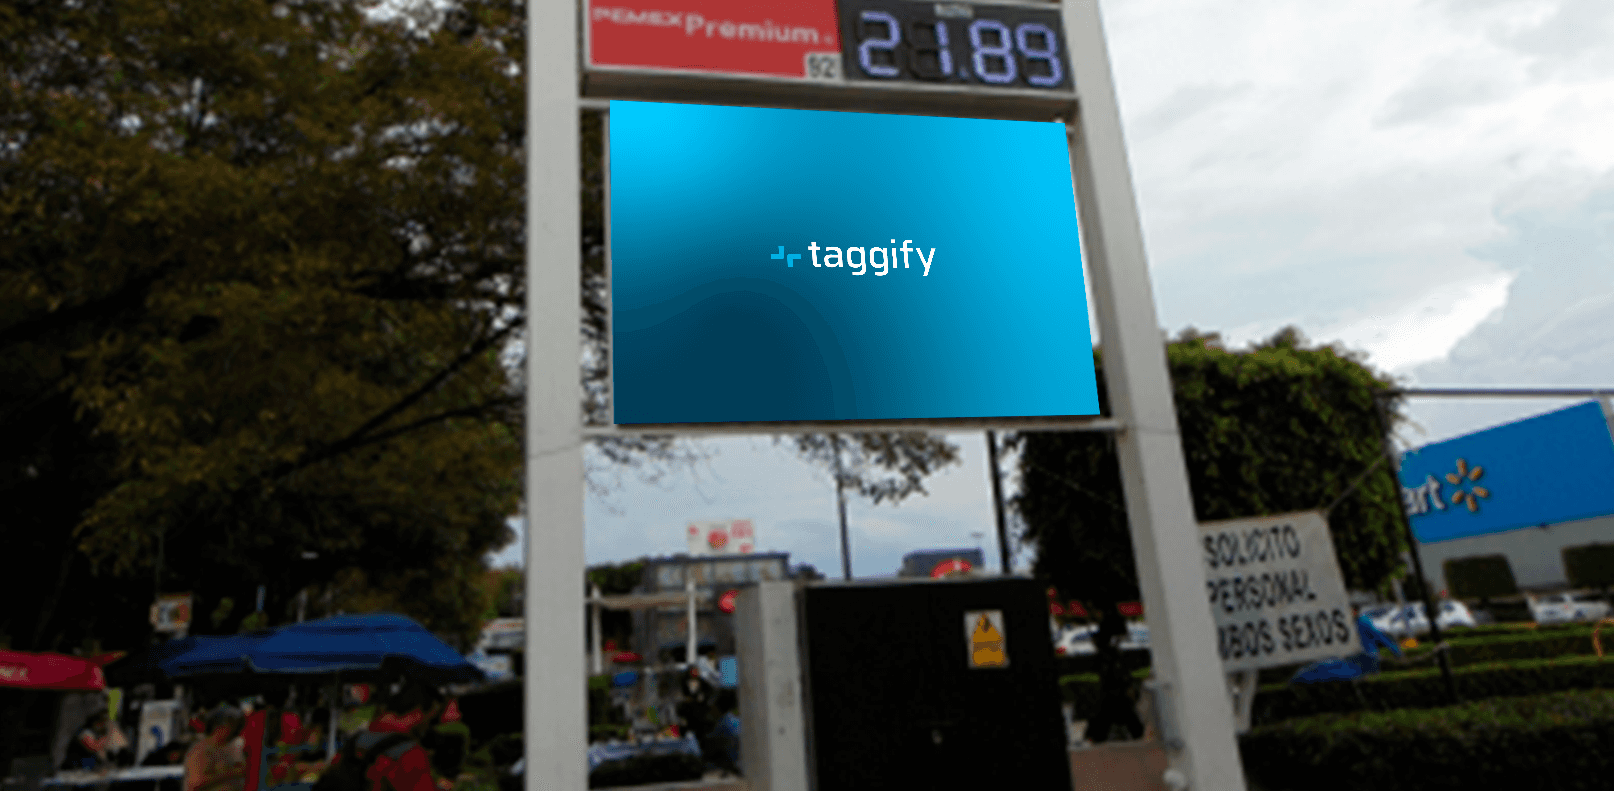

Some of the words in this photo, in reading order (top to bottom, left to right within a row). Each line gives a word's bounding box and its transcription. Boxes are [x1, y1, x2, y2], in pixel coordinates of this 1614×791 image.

[593, 7, 681, 28] PEMEX
[684, 13, 819, 44] Premium
[858, 10, 1064, 86] 21.89
[808, 239, 936, 277] taggify
[1203, 523, 1300, 568] SOLICITO
[1279, 609, 1350, 652] SEXOS
